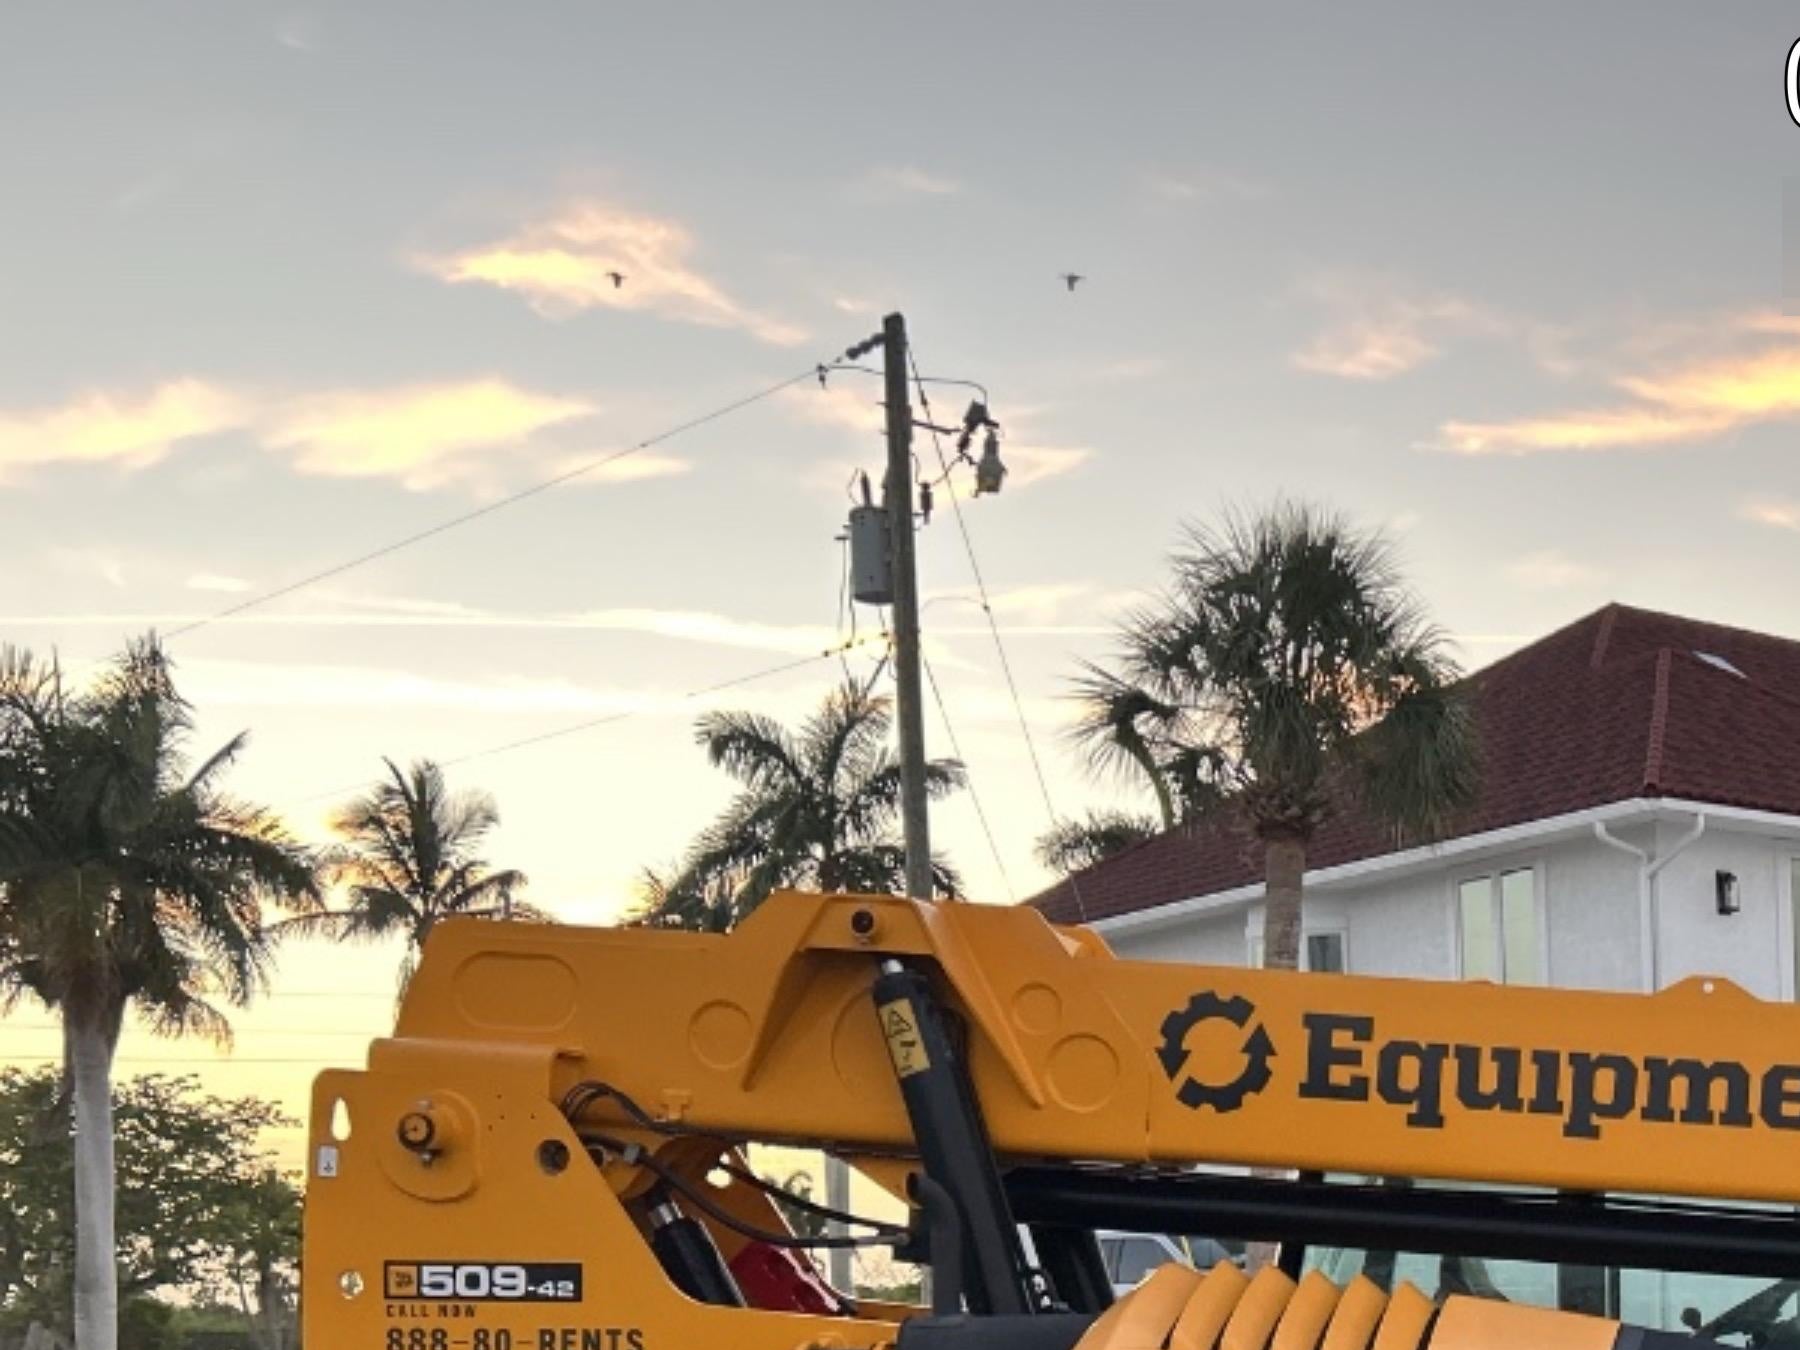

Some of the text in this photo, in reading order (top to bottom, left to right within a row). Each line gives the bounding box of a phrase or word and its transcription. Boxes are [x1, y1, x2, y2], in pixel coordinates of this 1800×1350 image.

[420, 1265, 576, 1298] 509-42
[386, 1304, 477, 1318] CALL NOW
